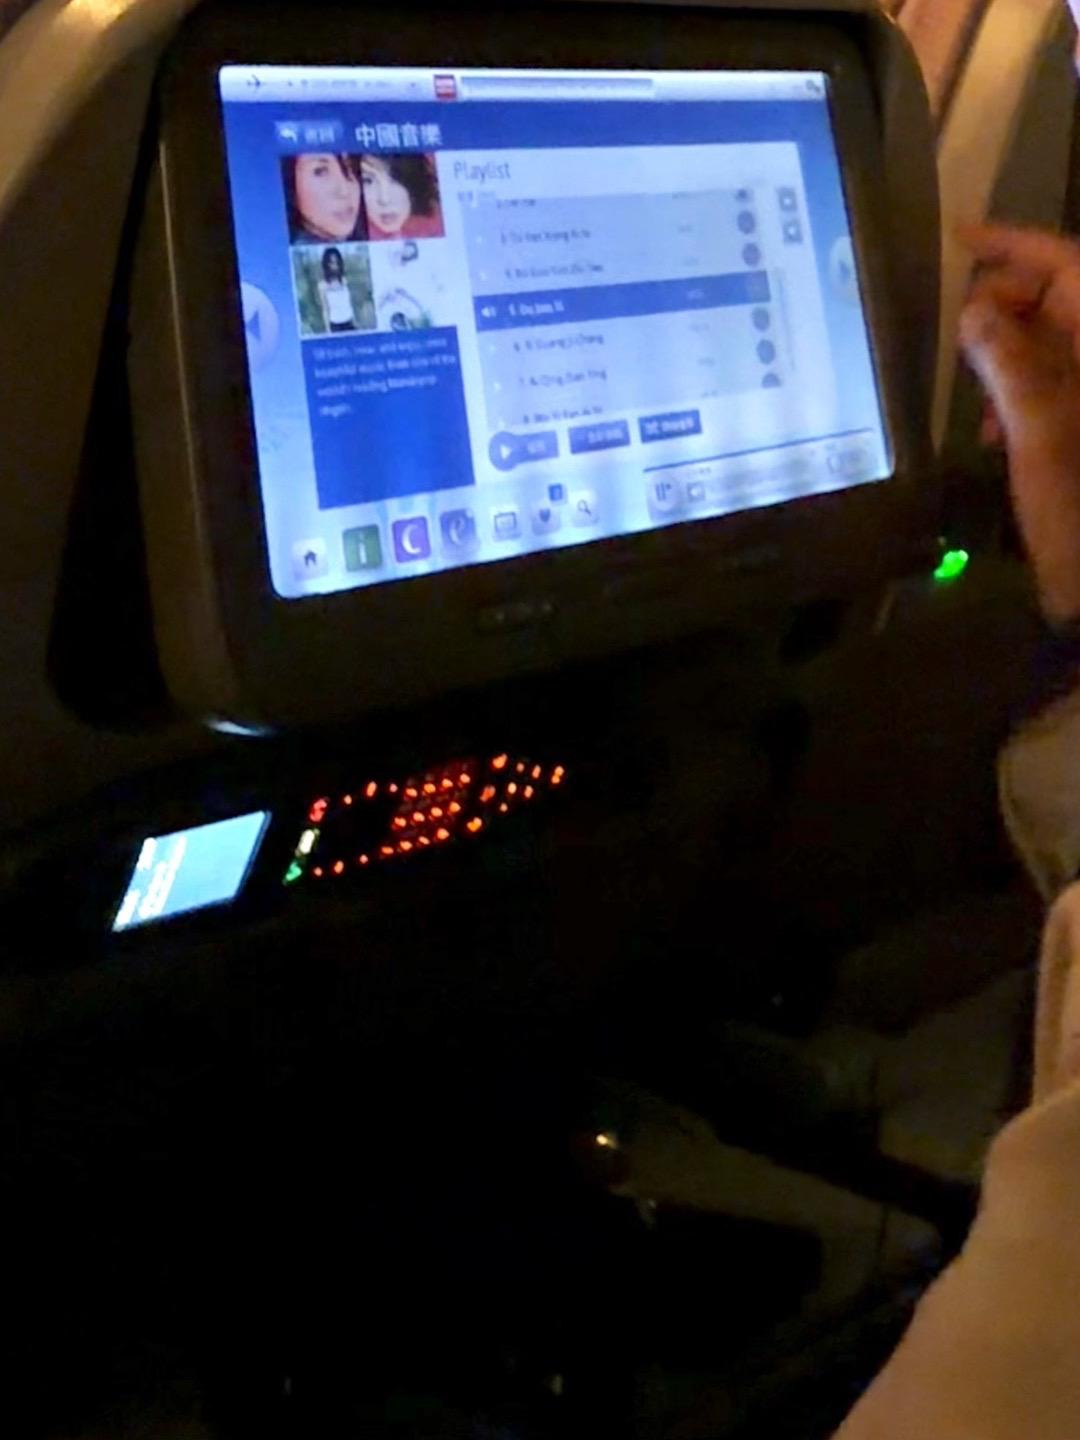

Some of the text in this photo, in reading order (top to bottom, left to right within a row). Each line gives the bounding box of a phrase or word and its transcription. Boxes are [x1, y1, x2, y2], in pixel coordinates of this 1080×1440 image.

[355, 122, 443, 148] 中國音樂
[453, 161, 511, 184] Playlist
